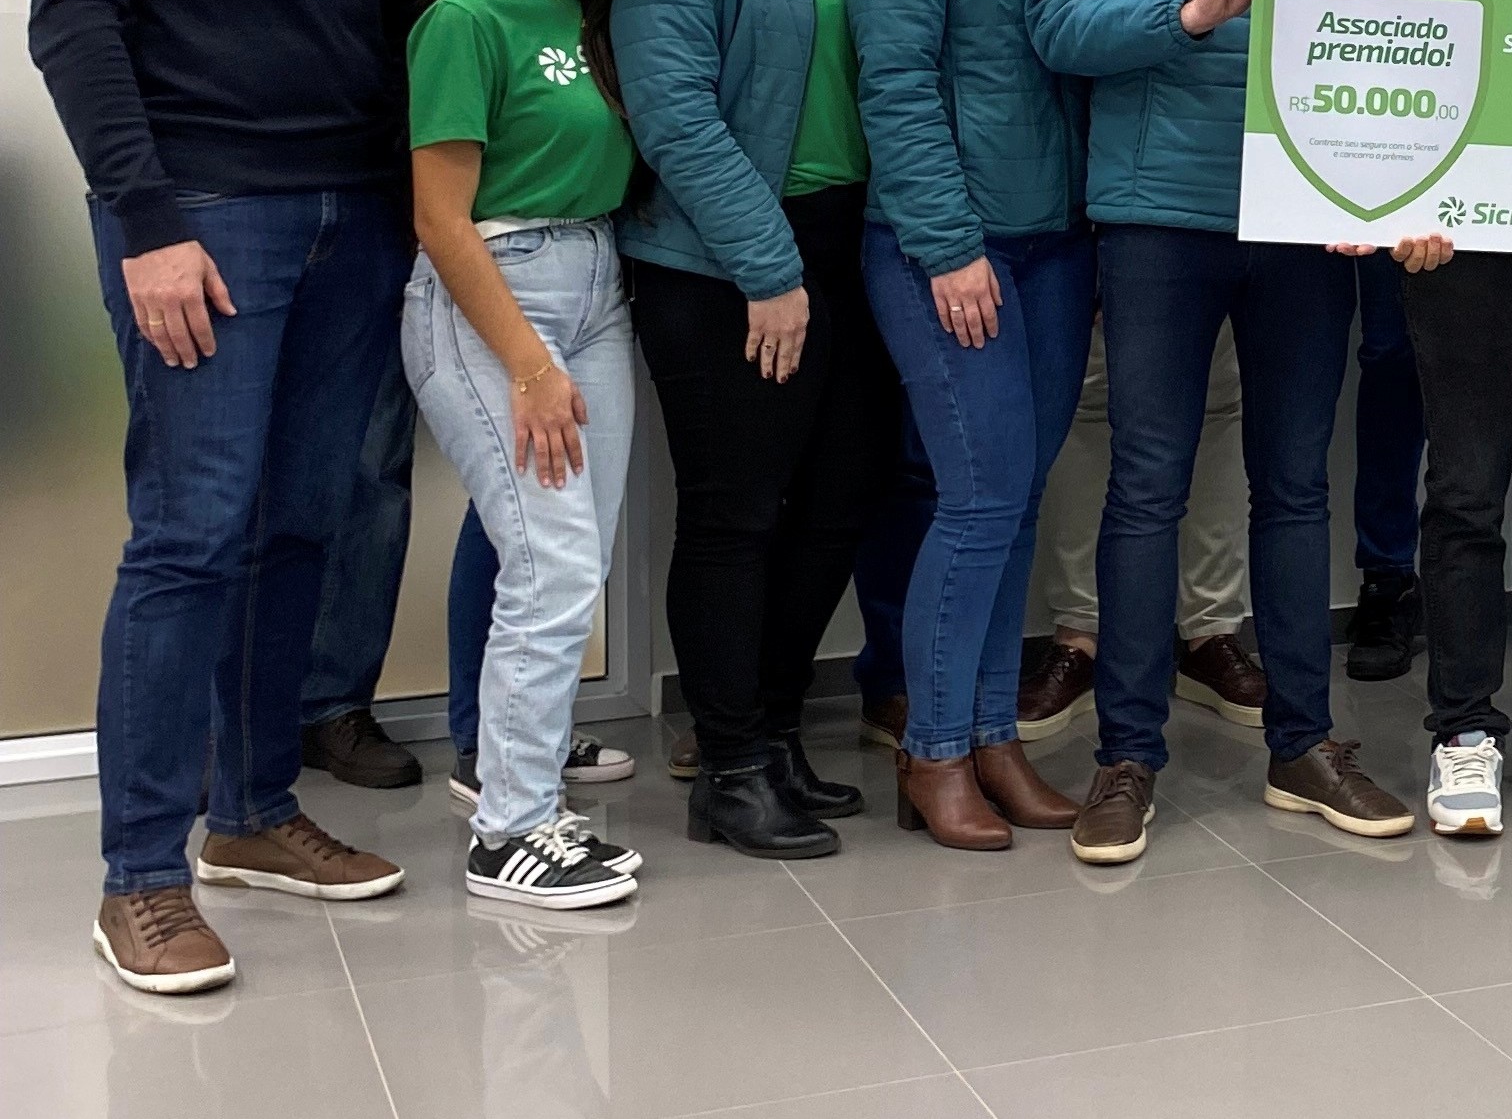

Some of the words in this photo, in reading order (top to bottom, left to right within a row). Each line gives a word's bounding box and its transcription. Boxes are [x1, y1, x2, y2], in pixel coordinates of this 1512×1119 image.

[1316, 11, 1449, 40] Associado
[1306, 39, 1455, 67] premiado!
[1308, 137, 1344, 148] Contrate
[1344, 140, 1359, 148] seu
[1359, 141, 1388, 151] seguro
[1388, 142, 1405, 151] com
[1413, 142, 1440, 152] Sicredi
